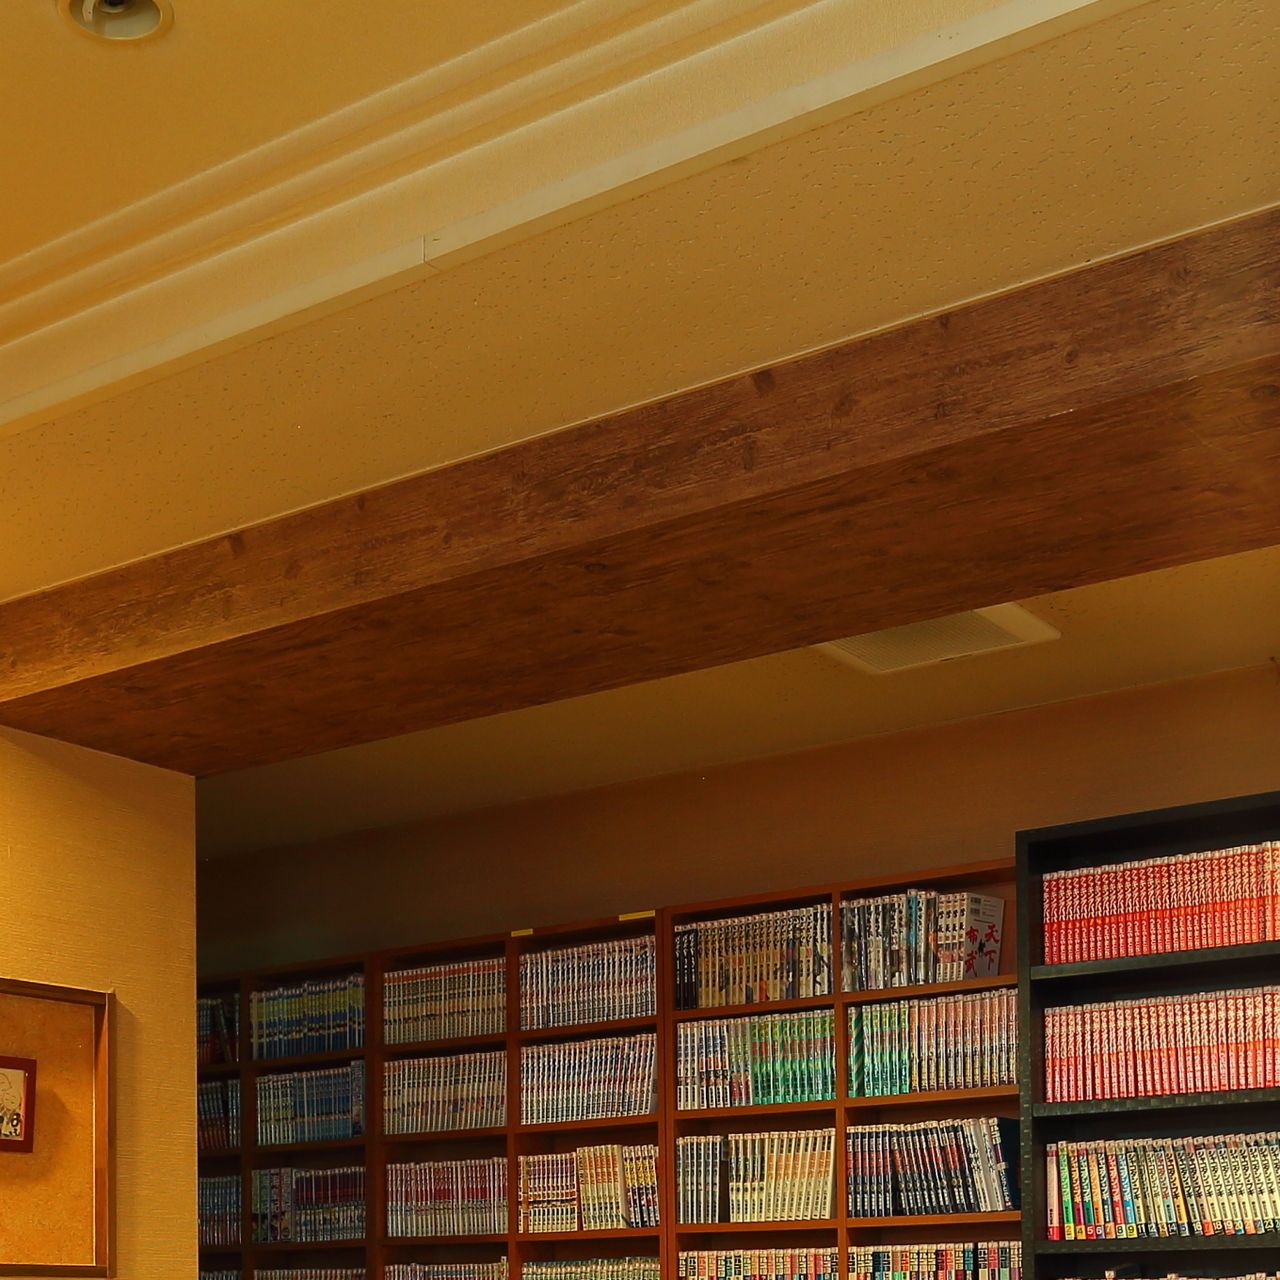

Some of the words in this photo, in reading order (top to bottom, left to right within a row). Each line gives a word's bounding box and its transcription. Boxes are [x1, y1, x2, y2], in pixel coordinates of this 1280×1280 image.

[1213, 1222, 1222, 1230] 18
[1265, 1219, 1274, 1228] 23
[1096, 1226, 1102, 1234] 6
[1117, 1225, 1123, 1234] 8
[1128, 1226, 1134, 1234] 9
